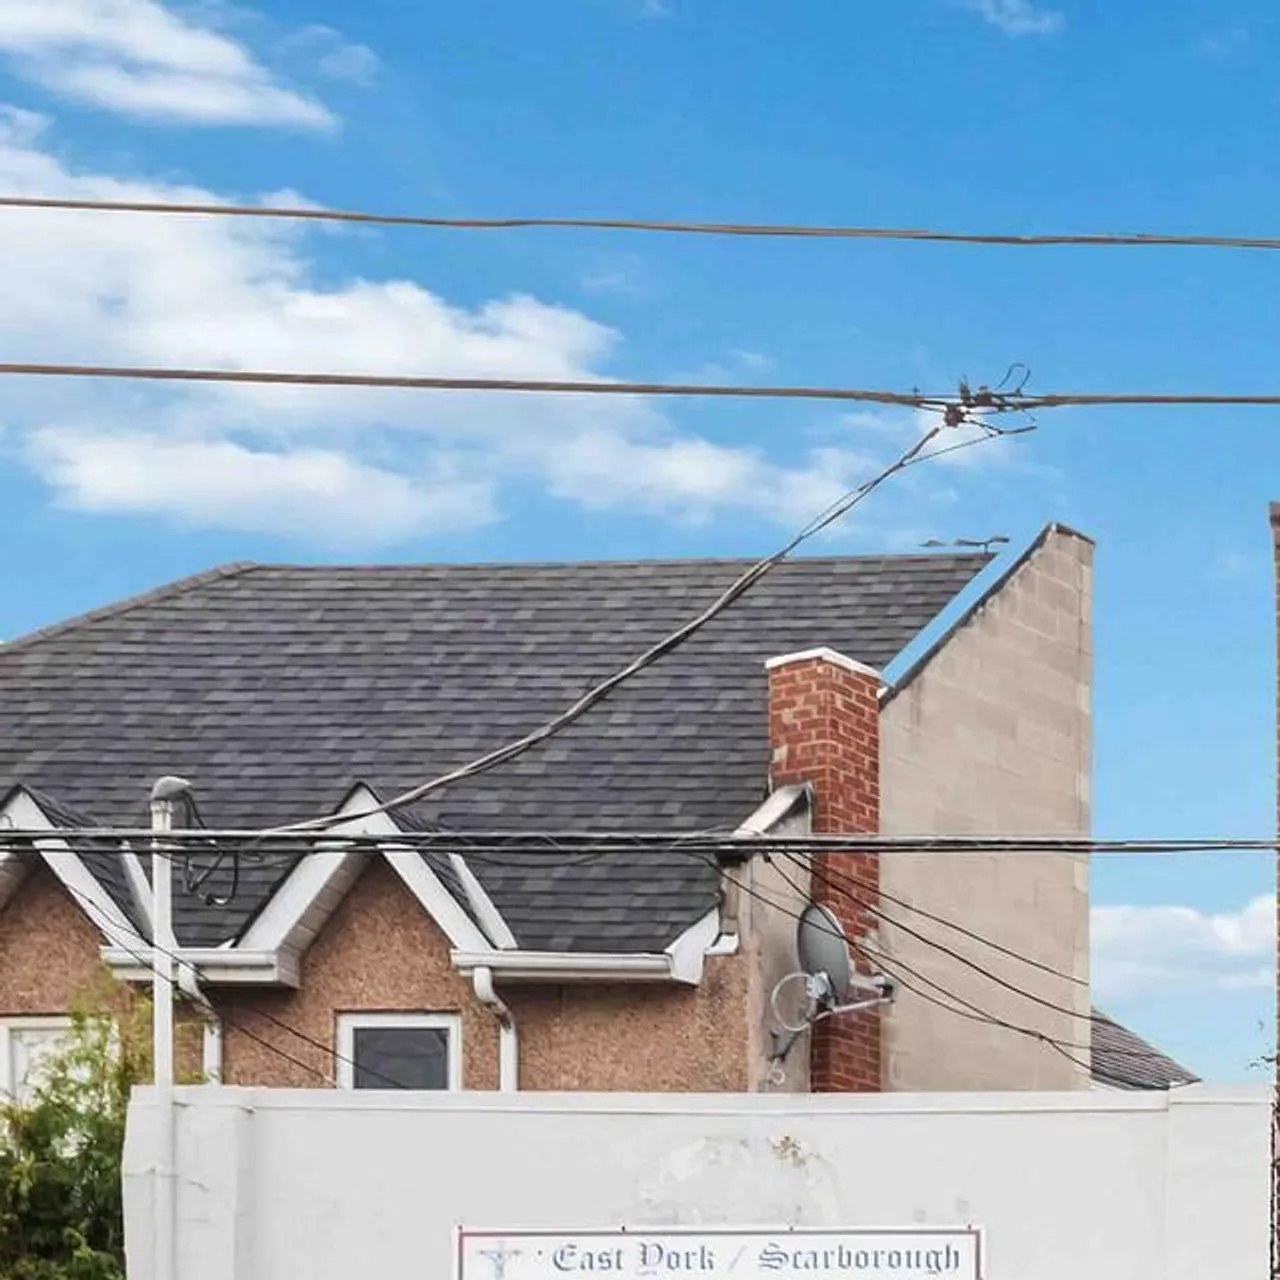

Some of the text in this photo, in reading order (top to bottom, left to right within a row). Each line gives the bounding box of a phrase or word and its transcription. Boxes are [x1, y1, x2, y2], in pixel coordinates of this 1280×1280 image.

[552, 1244, 623, 1271] East
[635, 1243, 714, 1276] York
[758, 1242, 960, 1275] Scarborough
